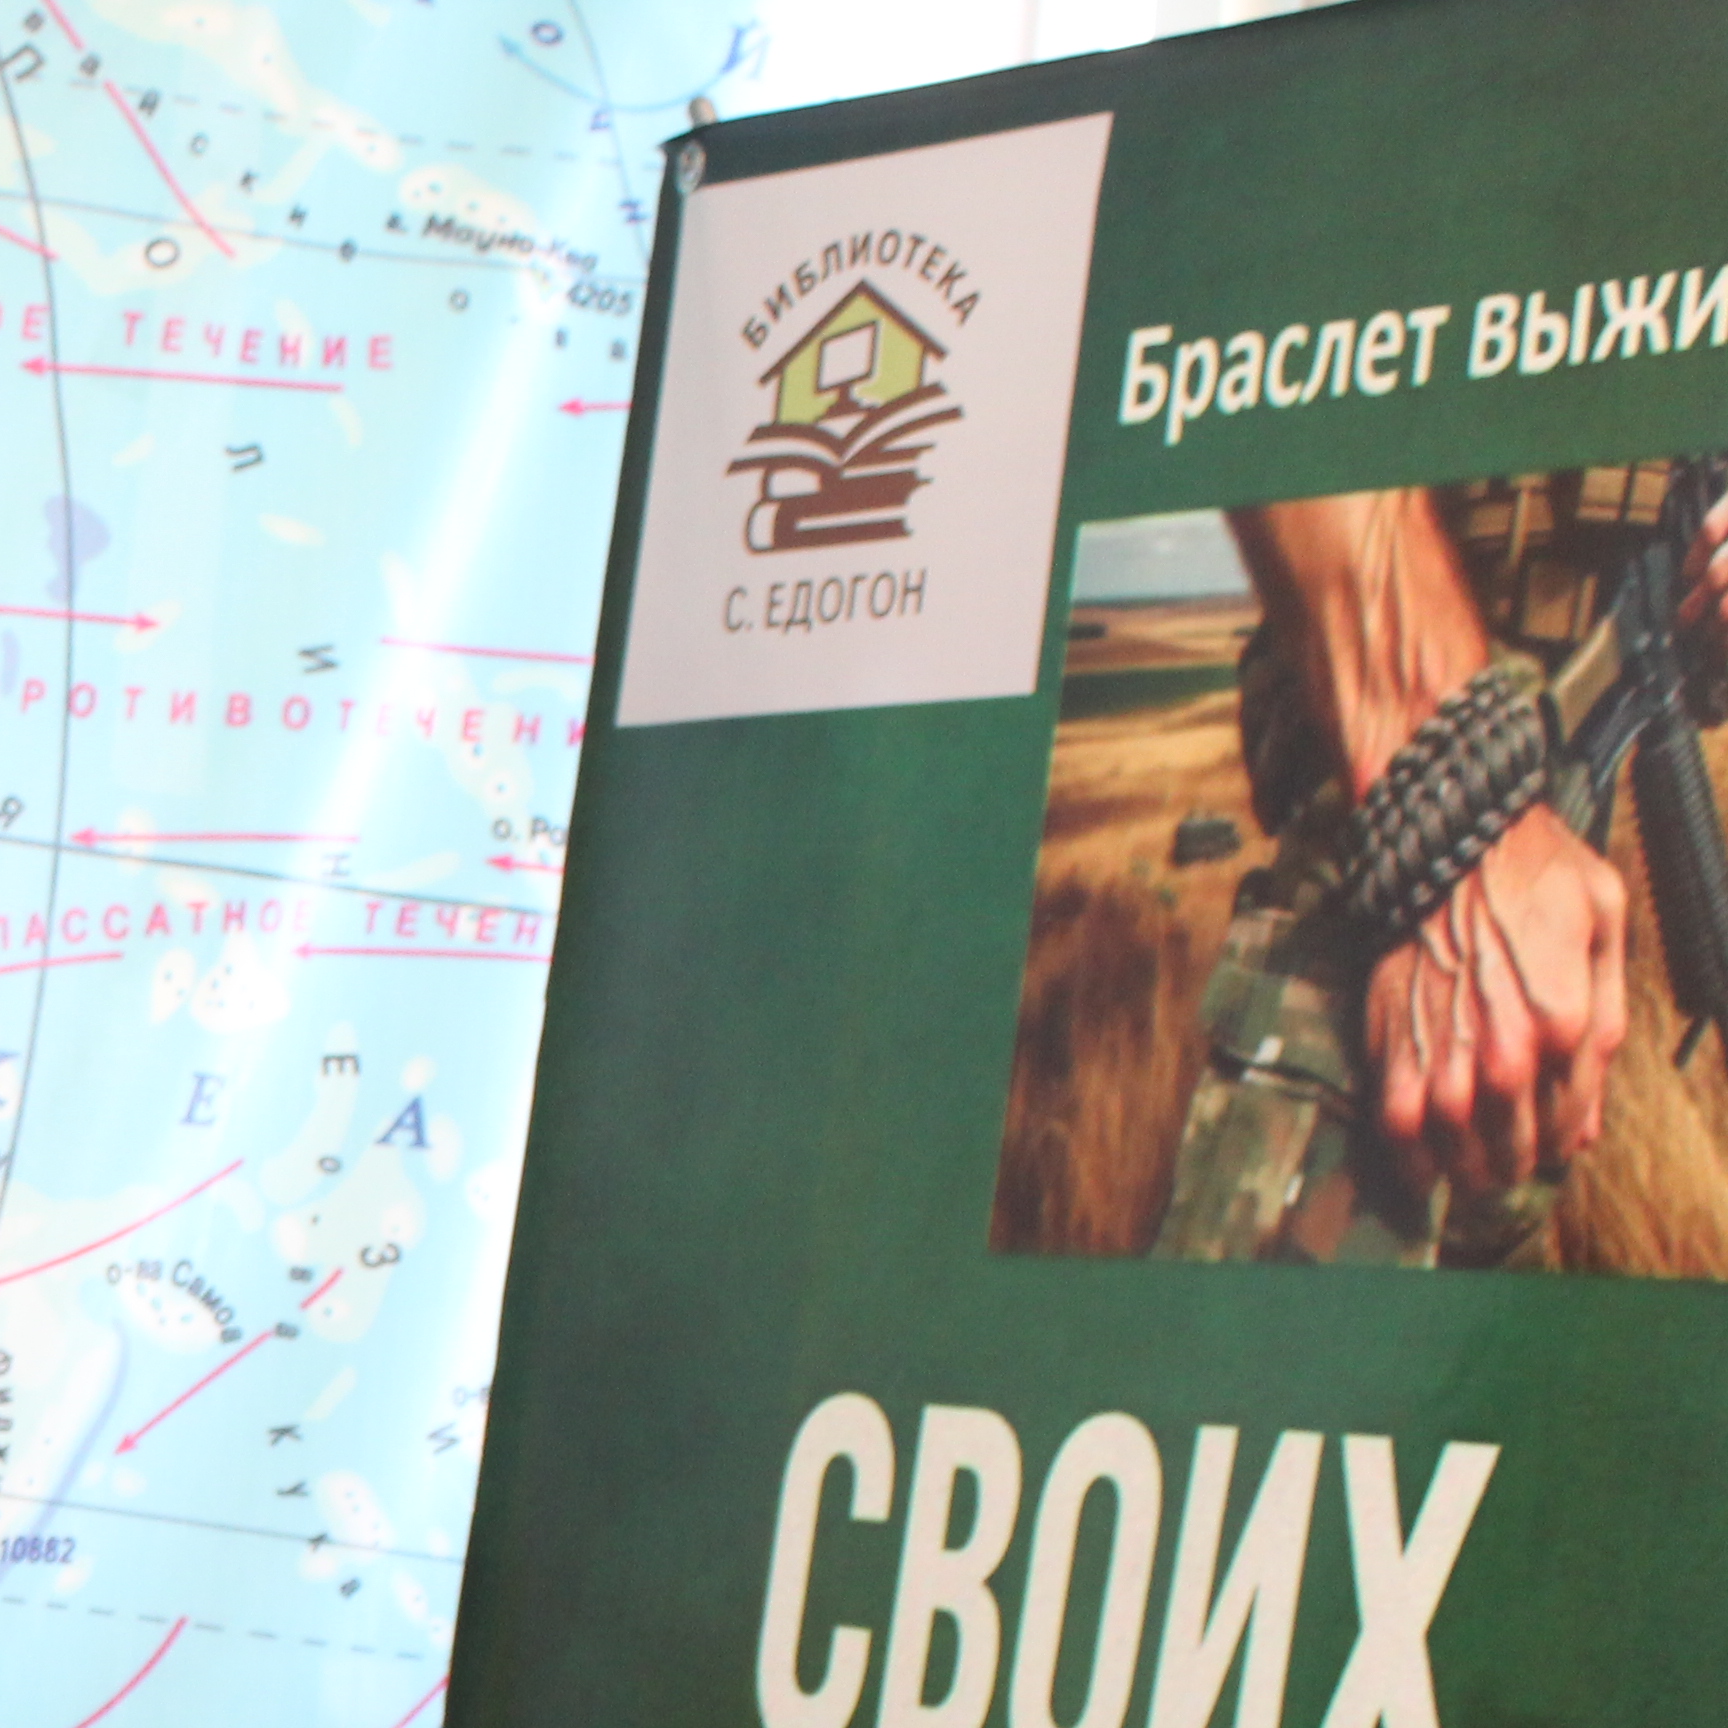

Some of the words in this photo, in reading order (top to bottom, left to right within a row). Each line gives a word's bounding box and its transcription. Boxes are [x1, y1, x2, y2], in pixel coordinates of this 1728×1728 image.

[742, 227, 984, 351] БИБЛИОТЕКА
[122, 312, 395, 371] ТЕЧЕНИЕ
[1118, 304, 1451, 447] Браслет
[724, 585, 755, 632] С.
[764, 568, 928, 635] ЕДОГОН
[364, 902, 543, 946] ТЕЧЕН
